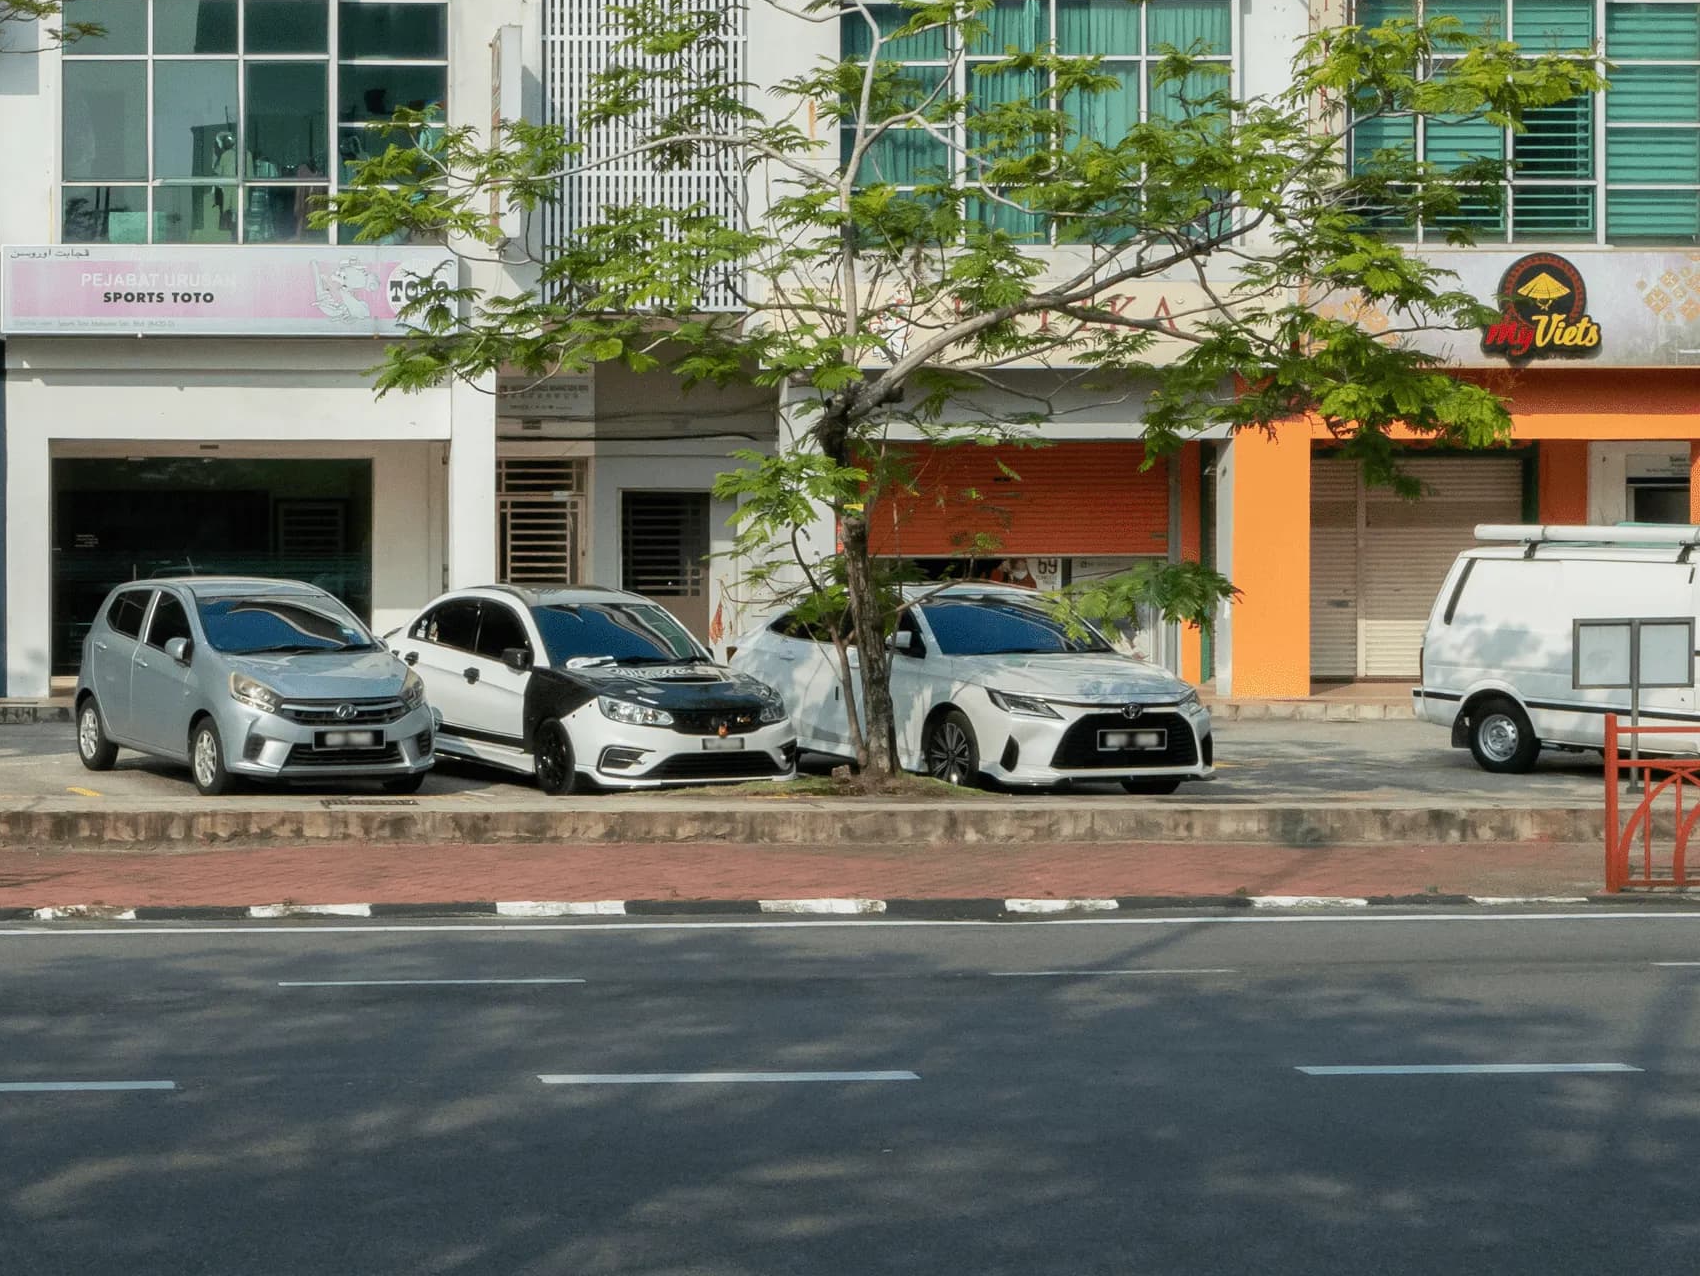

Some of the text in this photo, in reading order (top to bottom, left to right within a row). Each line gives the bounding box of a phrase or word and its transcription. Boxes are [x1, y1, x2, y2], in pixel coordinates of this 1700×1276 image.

[81, 274, 236, 287] PEJABAT URUSAN
[103, 292, 215, 303] SPORTS TOTO
